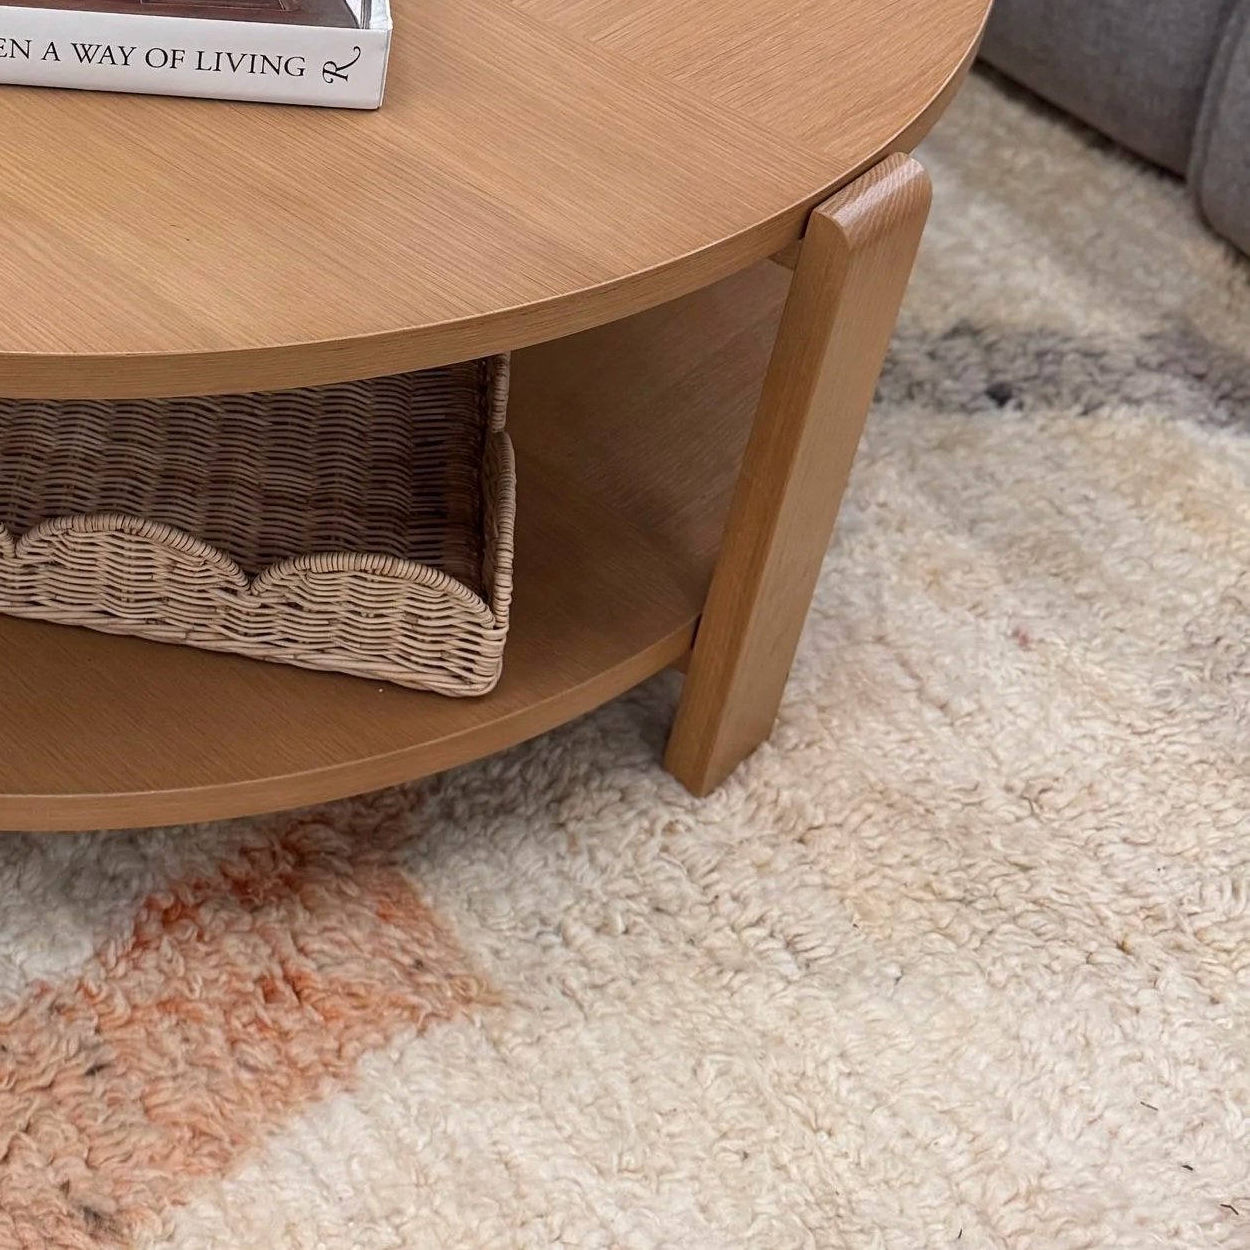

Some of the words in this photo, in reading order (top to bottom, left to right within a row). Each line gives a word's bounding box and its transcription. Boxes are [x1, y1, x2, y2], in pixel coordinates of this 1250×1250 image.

[41, 41, 61, 62] A
[70, 43, 137, 67] WAY
[145, 47, 186, 69] OF
[195, 50, 306, 77] LIVING
